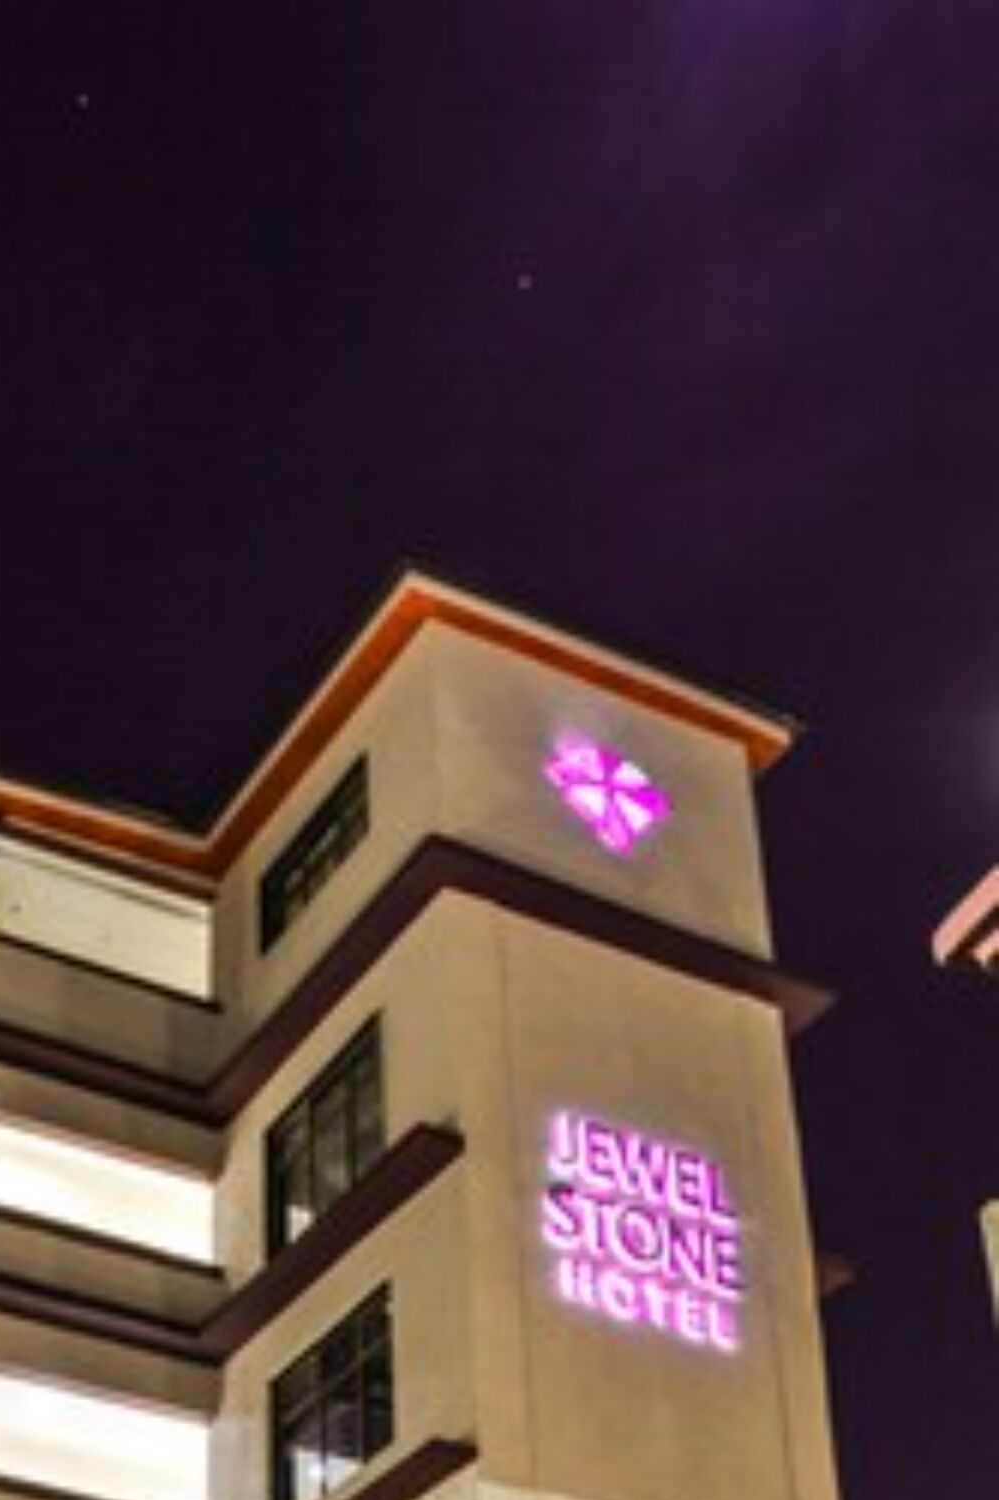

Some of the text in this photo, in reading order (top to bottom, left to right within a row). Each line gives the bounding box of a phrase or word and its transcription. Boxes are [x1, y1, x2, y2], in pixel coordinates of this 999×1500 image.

[549, 1112, 738, 1230] JEWEL
[542, 1190, 742, 1299] STONE
[558, 1258, 739, 1354] HOTEL
